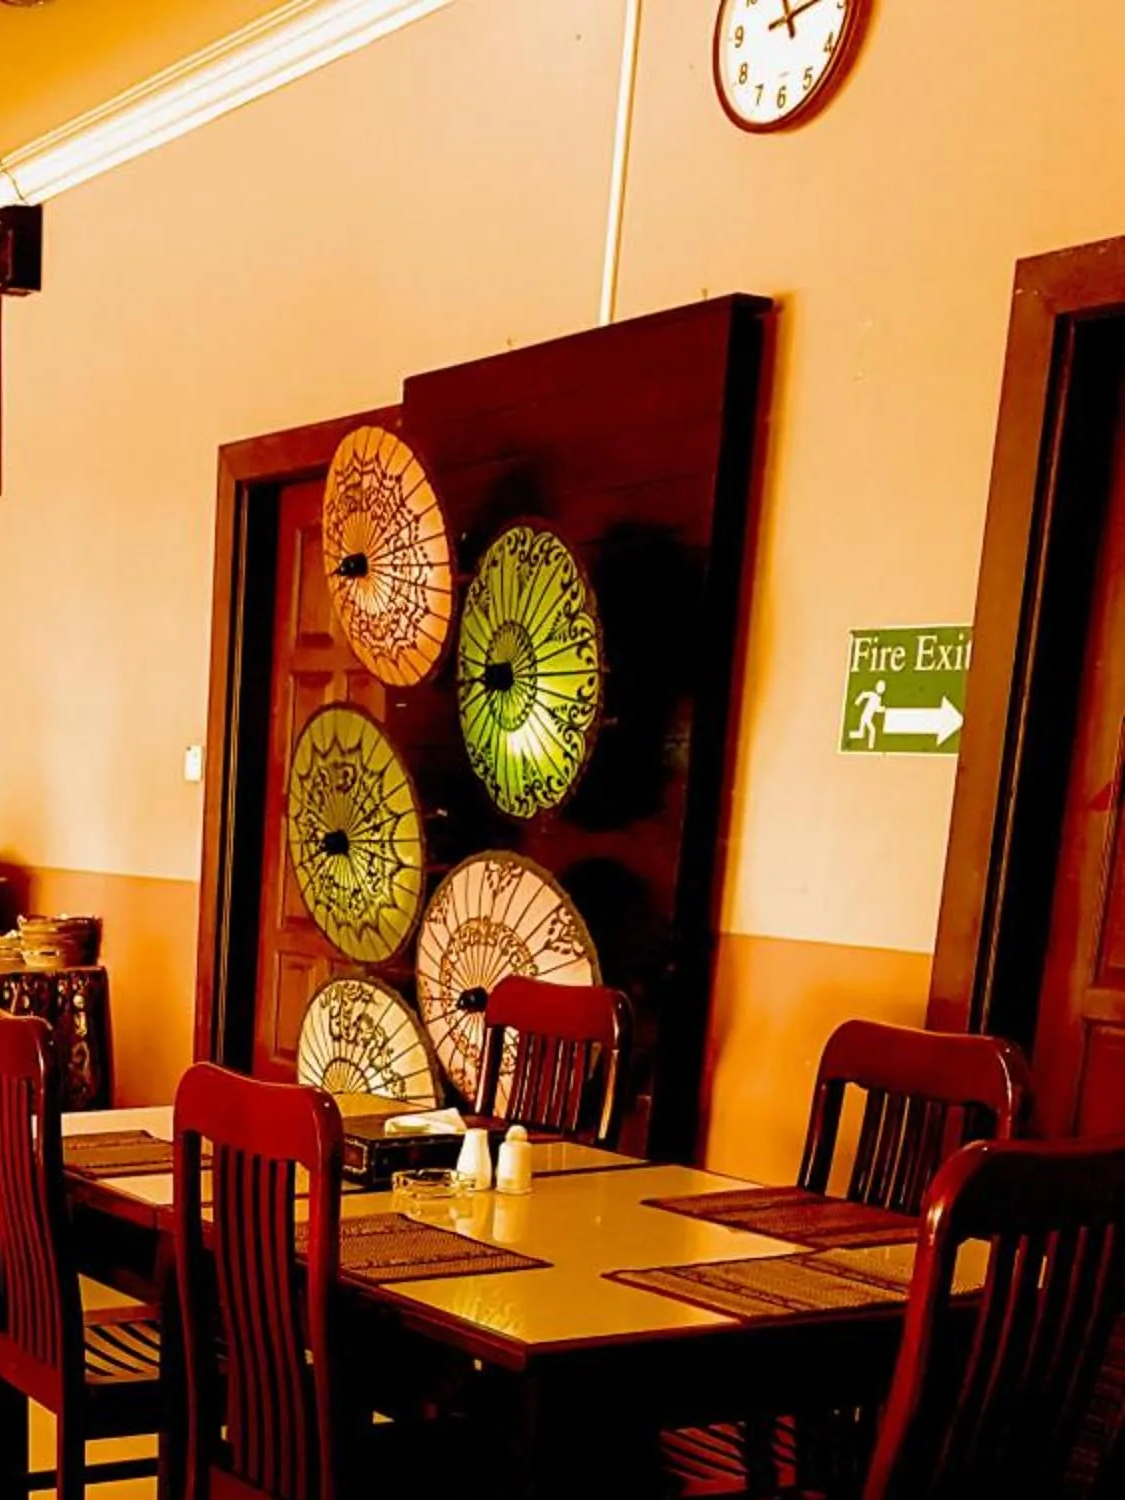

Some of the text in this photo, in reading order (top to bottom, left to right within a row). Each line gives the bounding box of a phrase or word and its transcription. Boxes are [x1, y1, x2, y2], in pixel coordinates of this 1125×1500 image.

[734, 25, 744, 48] 9
[823, 32, 834, 52] 4
[738, 63, 748, 85] 8
[803, 67, 813, 90] 5
[755, 84, 764, 105] 7
[777, 86, 786, 108] 6
[850, 636, 906, 672] Fire
